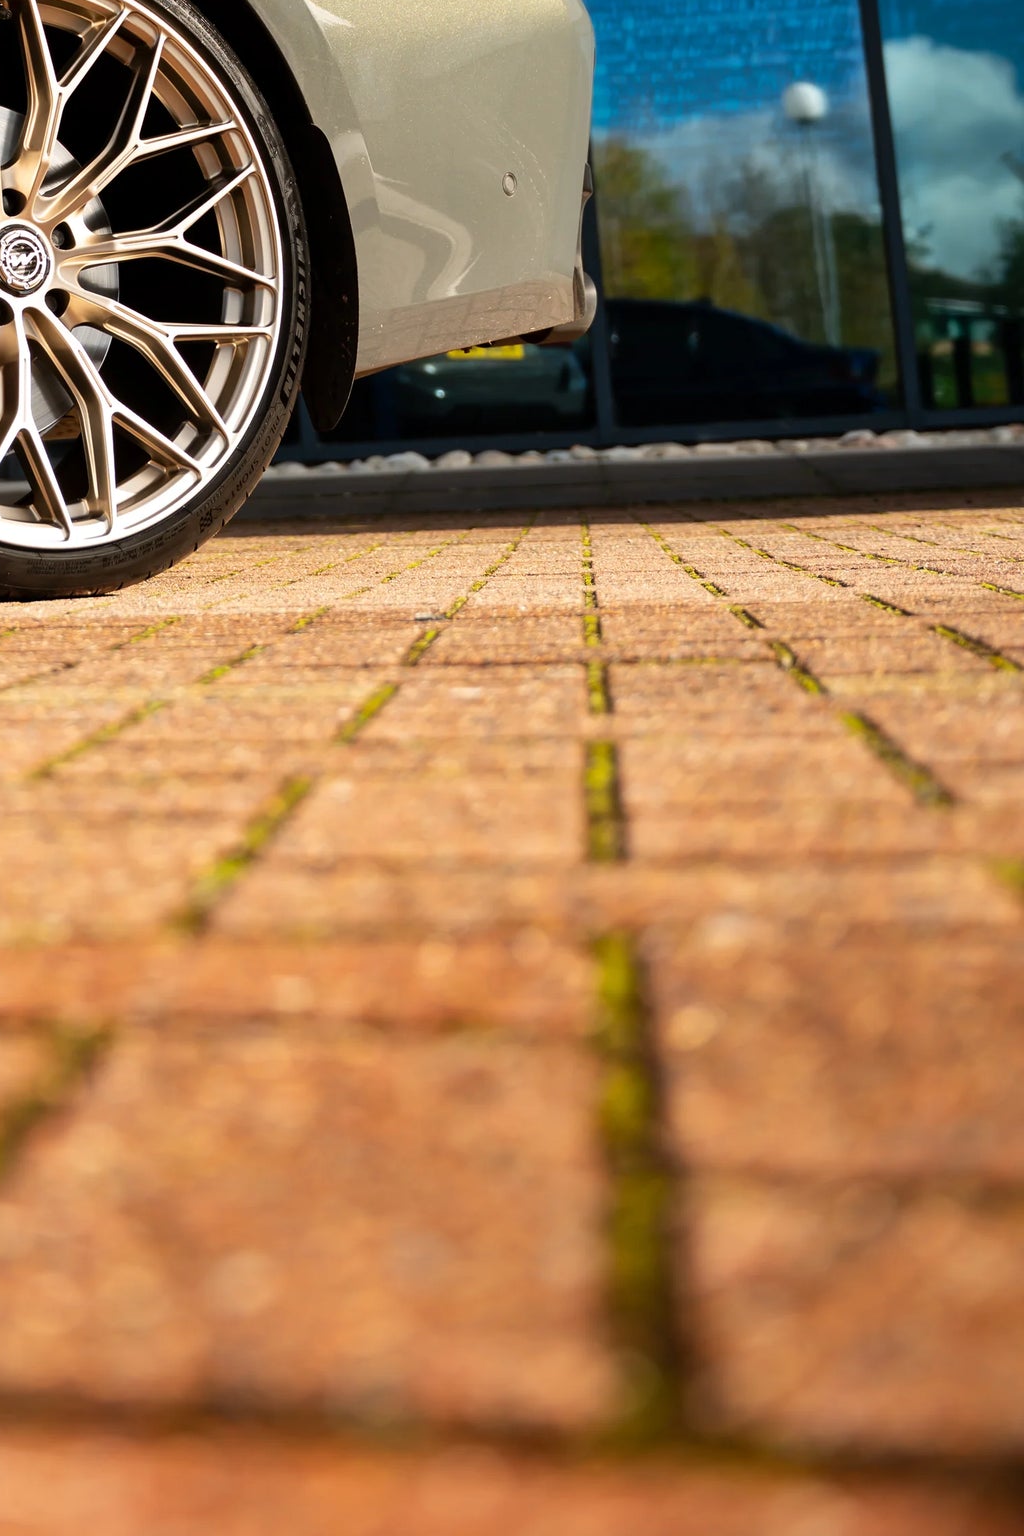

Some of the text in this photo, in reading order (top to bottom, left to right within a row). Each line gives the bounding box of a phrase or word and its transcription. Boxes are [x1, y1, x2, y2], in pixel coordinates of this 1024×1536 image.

[282, 236, 306, 396] MICHELIN
[261, 415, 280, 453] PILOT
[231, 459, 259, 496] SPORT
